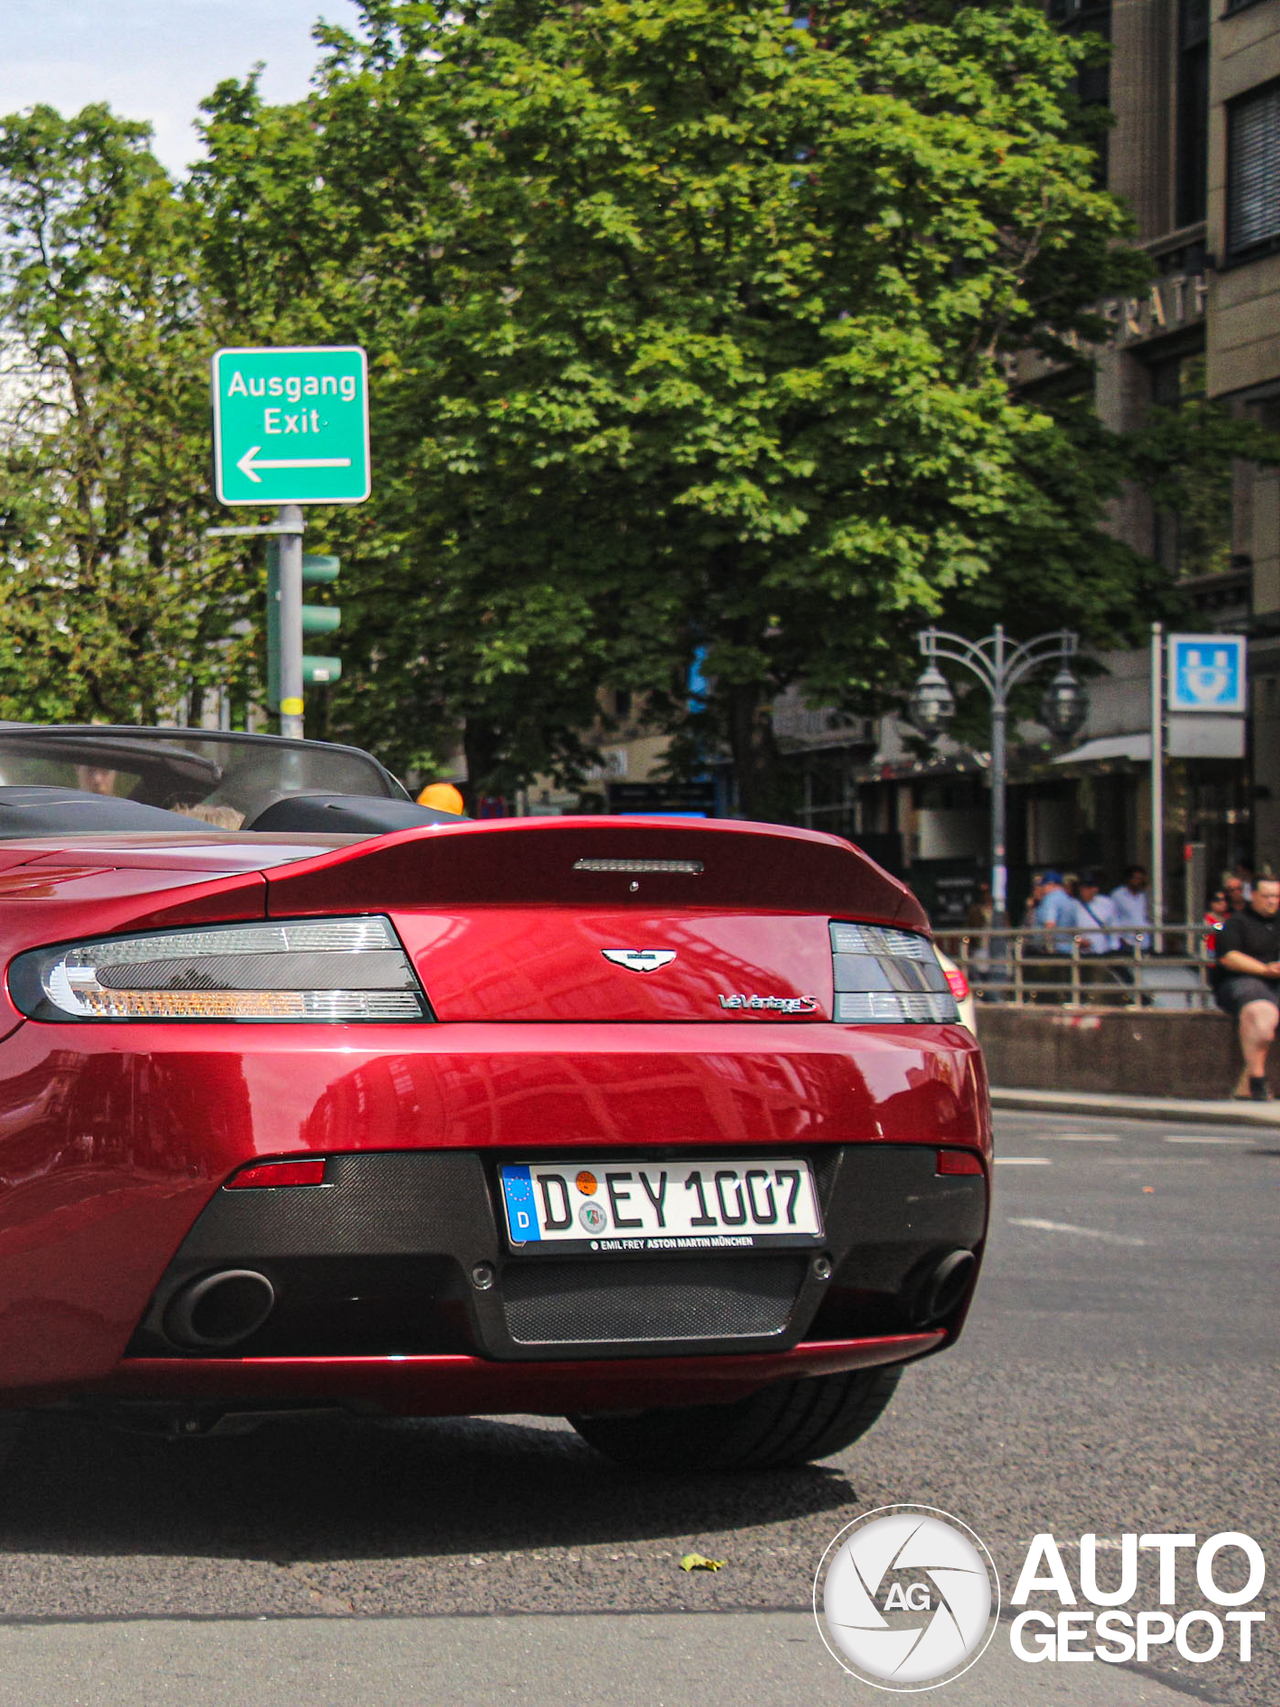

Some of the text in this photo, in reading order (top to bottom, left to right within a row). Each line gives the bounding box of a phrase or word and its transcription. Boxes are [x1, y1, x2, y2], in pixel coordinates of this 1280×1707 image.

[227, 370, 357, 403] Ausgang
[263, 407, 321, 435] Exit
[536, 1168, 801, 1231] D EY 1007
[518, 1211, 531, 1229] D
[601, 1235, 754, 1251] EMIL FREY ASTON MARTIN MÜNCHEN
